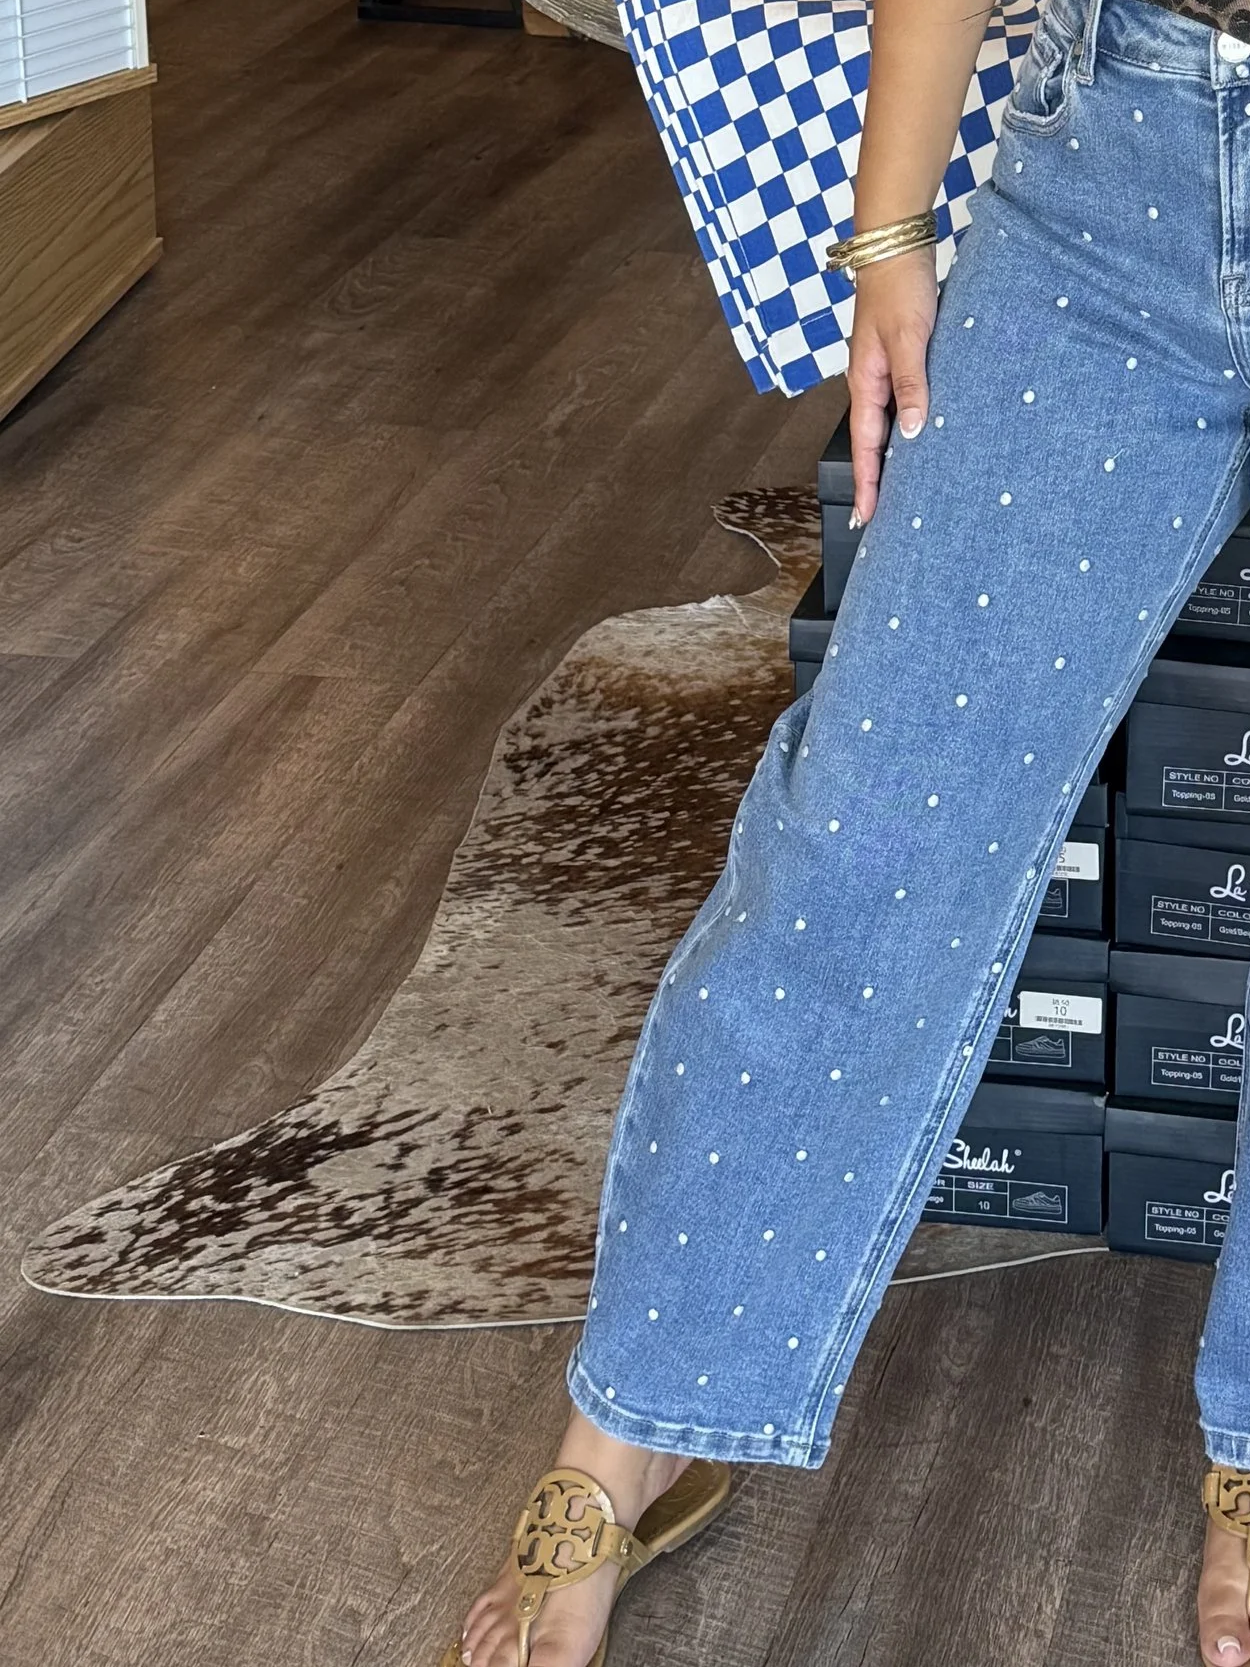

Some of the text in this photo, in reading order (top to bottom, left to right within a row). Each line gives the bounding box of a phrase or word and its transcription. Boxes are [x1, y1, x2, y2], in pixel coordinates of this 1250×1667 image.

[1168, 771, 1219, 783] STYLE NO
[1157, 901, 1206, 914] STYLE NO
[1054, 1006, 1068, 1017] 10
[1157, 1051, 1206, 1064] STYLE NO
[1218, 1058, 1242, 1067] COL
[943, 1138, 1015, 1174] Sheelah
[967, 1180, 995, 1191] SIZE
[977, 1200, 991, 1211] 10
[1151, 1206, 1200, 1219] STYLE NO
